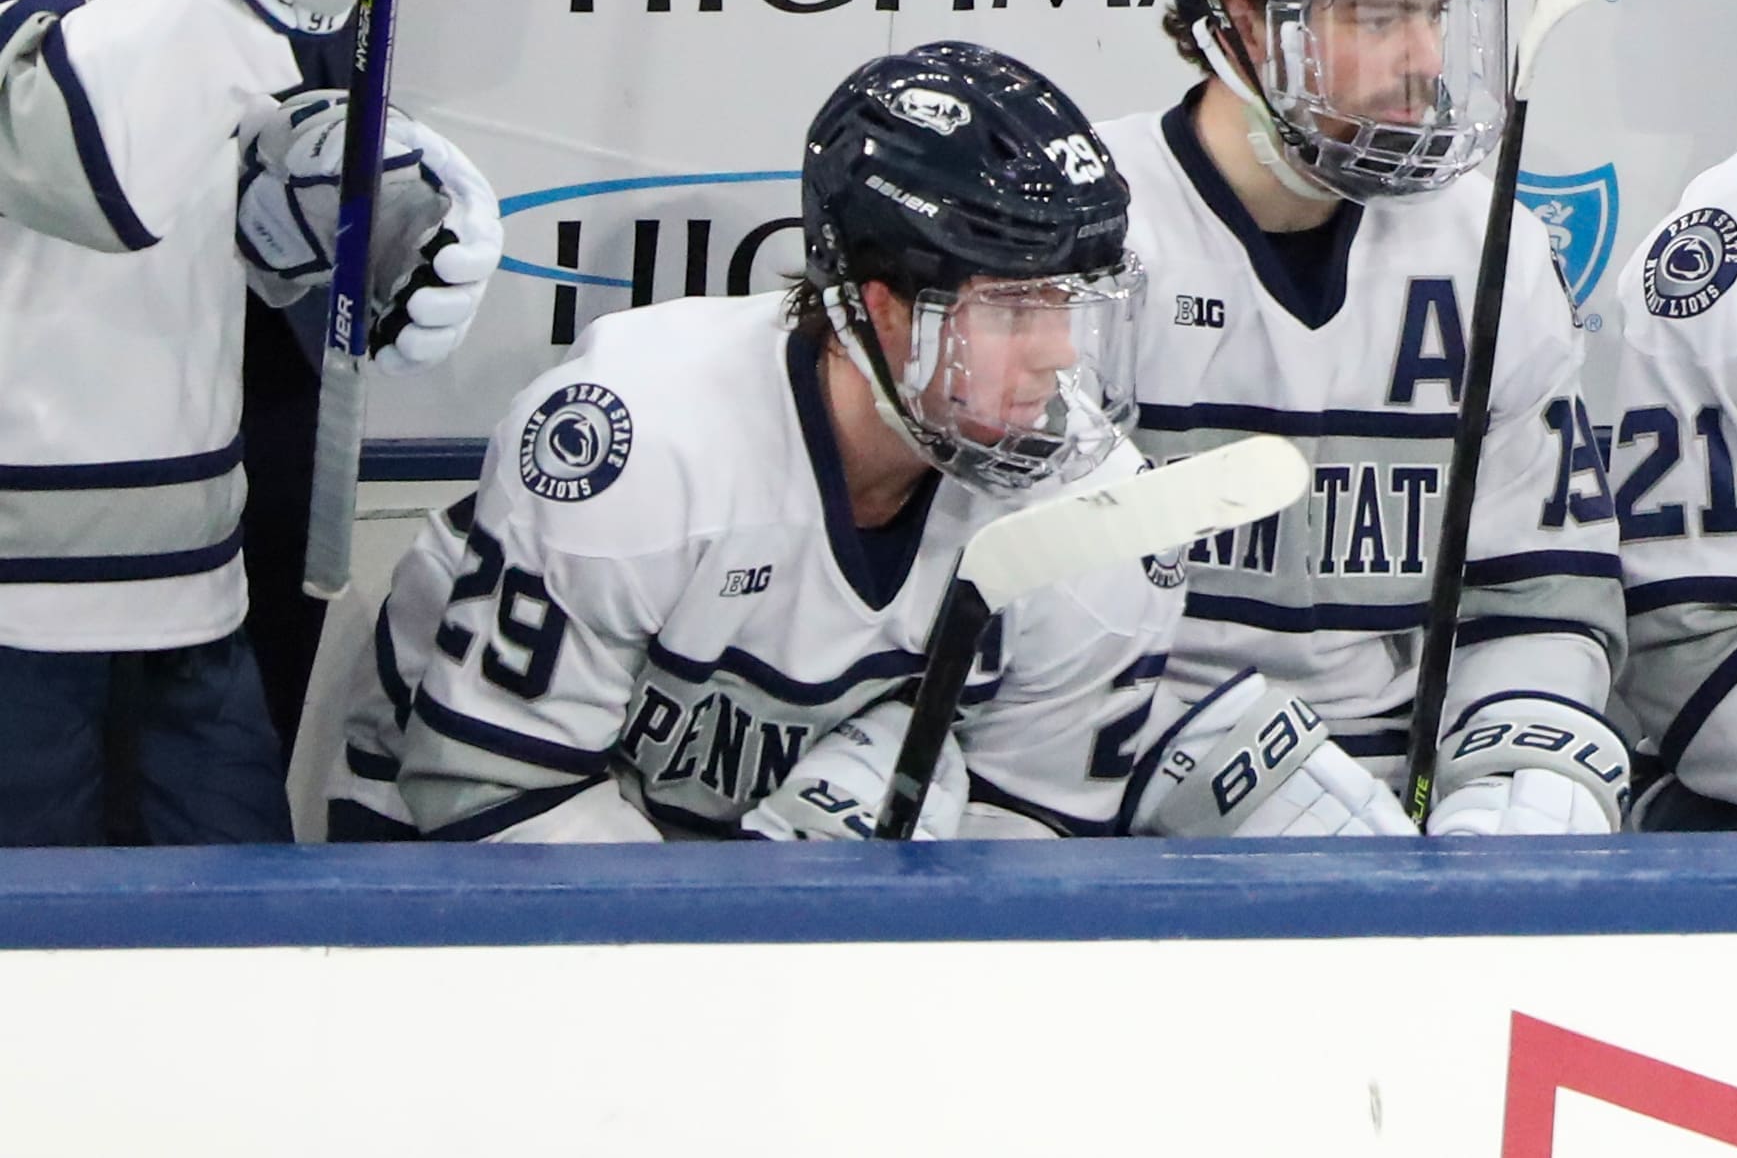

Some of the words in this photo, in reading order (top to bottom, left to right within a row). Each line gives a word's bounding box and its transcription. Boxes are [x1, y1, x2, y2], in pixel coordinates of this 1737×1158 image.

[1667, 209, 1714, 238] PENN
[1668, 284, 1721, 316] LIONS
[1383, 275, 1468, 407] A
[534, 474, 593, 500] LIONS
[1312, 460, 1445, 579] TAT
[436, 522, 570, 704] 29
[1161, 749, 1197, 786] 19
